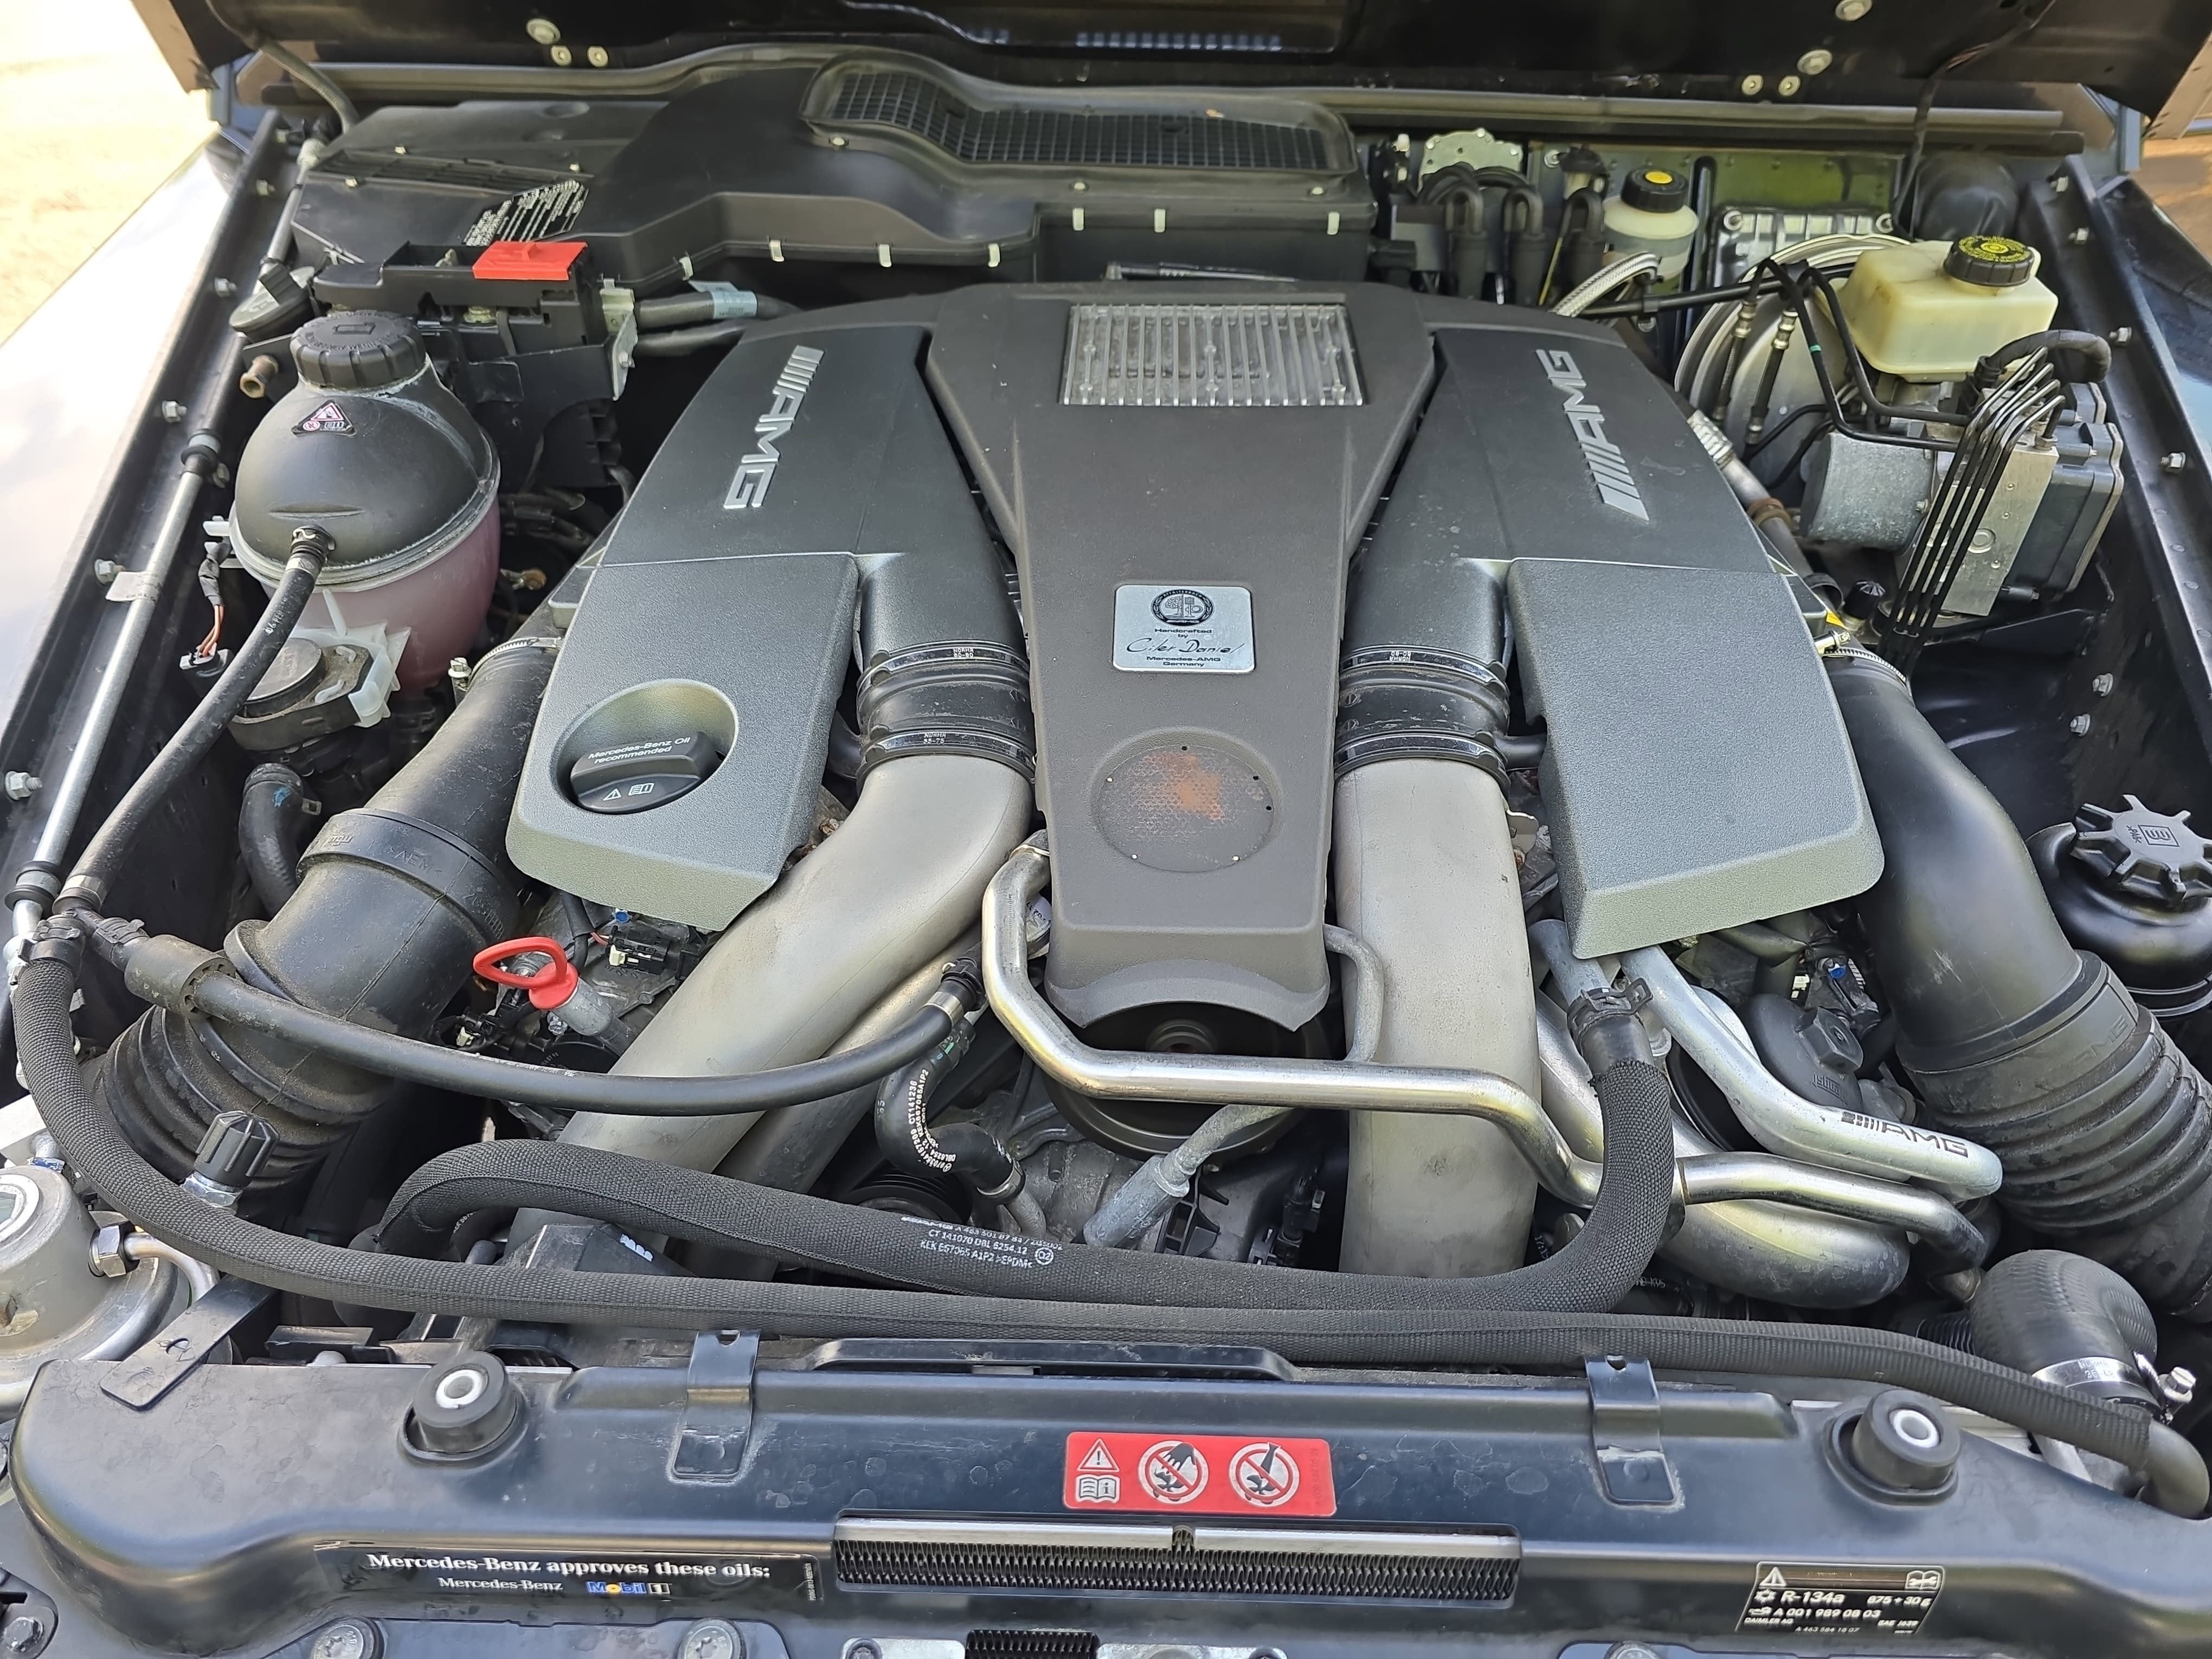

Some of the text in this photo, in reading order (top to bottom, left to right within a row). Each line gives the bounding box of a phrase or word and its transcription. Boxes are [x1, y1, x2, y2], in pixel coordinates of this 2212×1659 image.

[723, 386, 806, 509] AMG
[588, 737, 691, 759] Mercedes-Benz Oil
[594, 745, 673, 764] recommended
[1881, 1122, 1969, 1158] AMG
[928, 1229, 941, 1238] CT
[366, 1553, 771, 1578] Mercedes-Benz approves these oils:
[438, 1577, 563, 1591] Mercedes-Benz
[586, 1580, 647, 1595] Mobil
[1780, 1589, 1846, 1604] R-134a
[1904, 1596, 1921, 1605] 30
[1773, 1607, 1882, 1619] A 001 989 08 03
